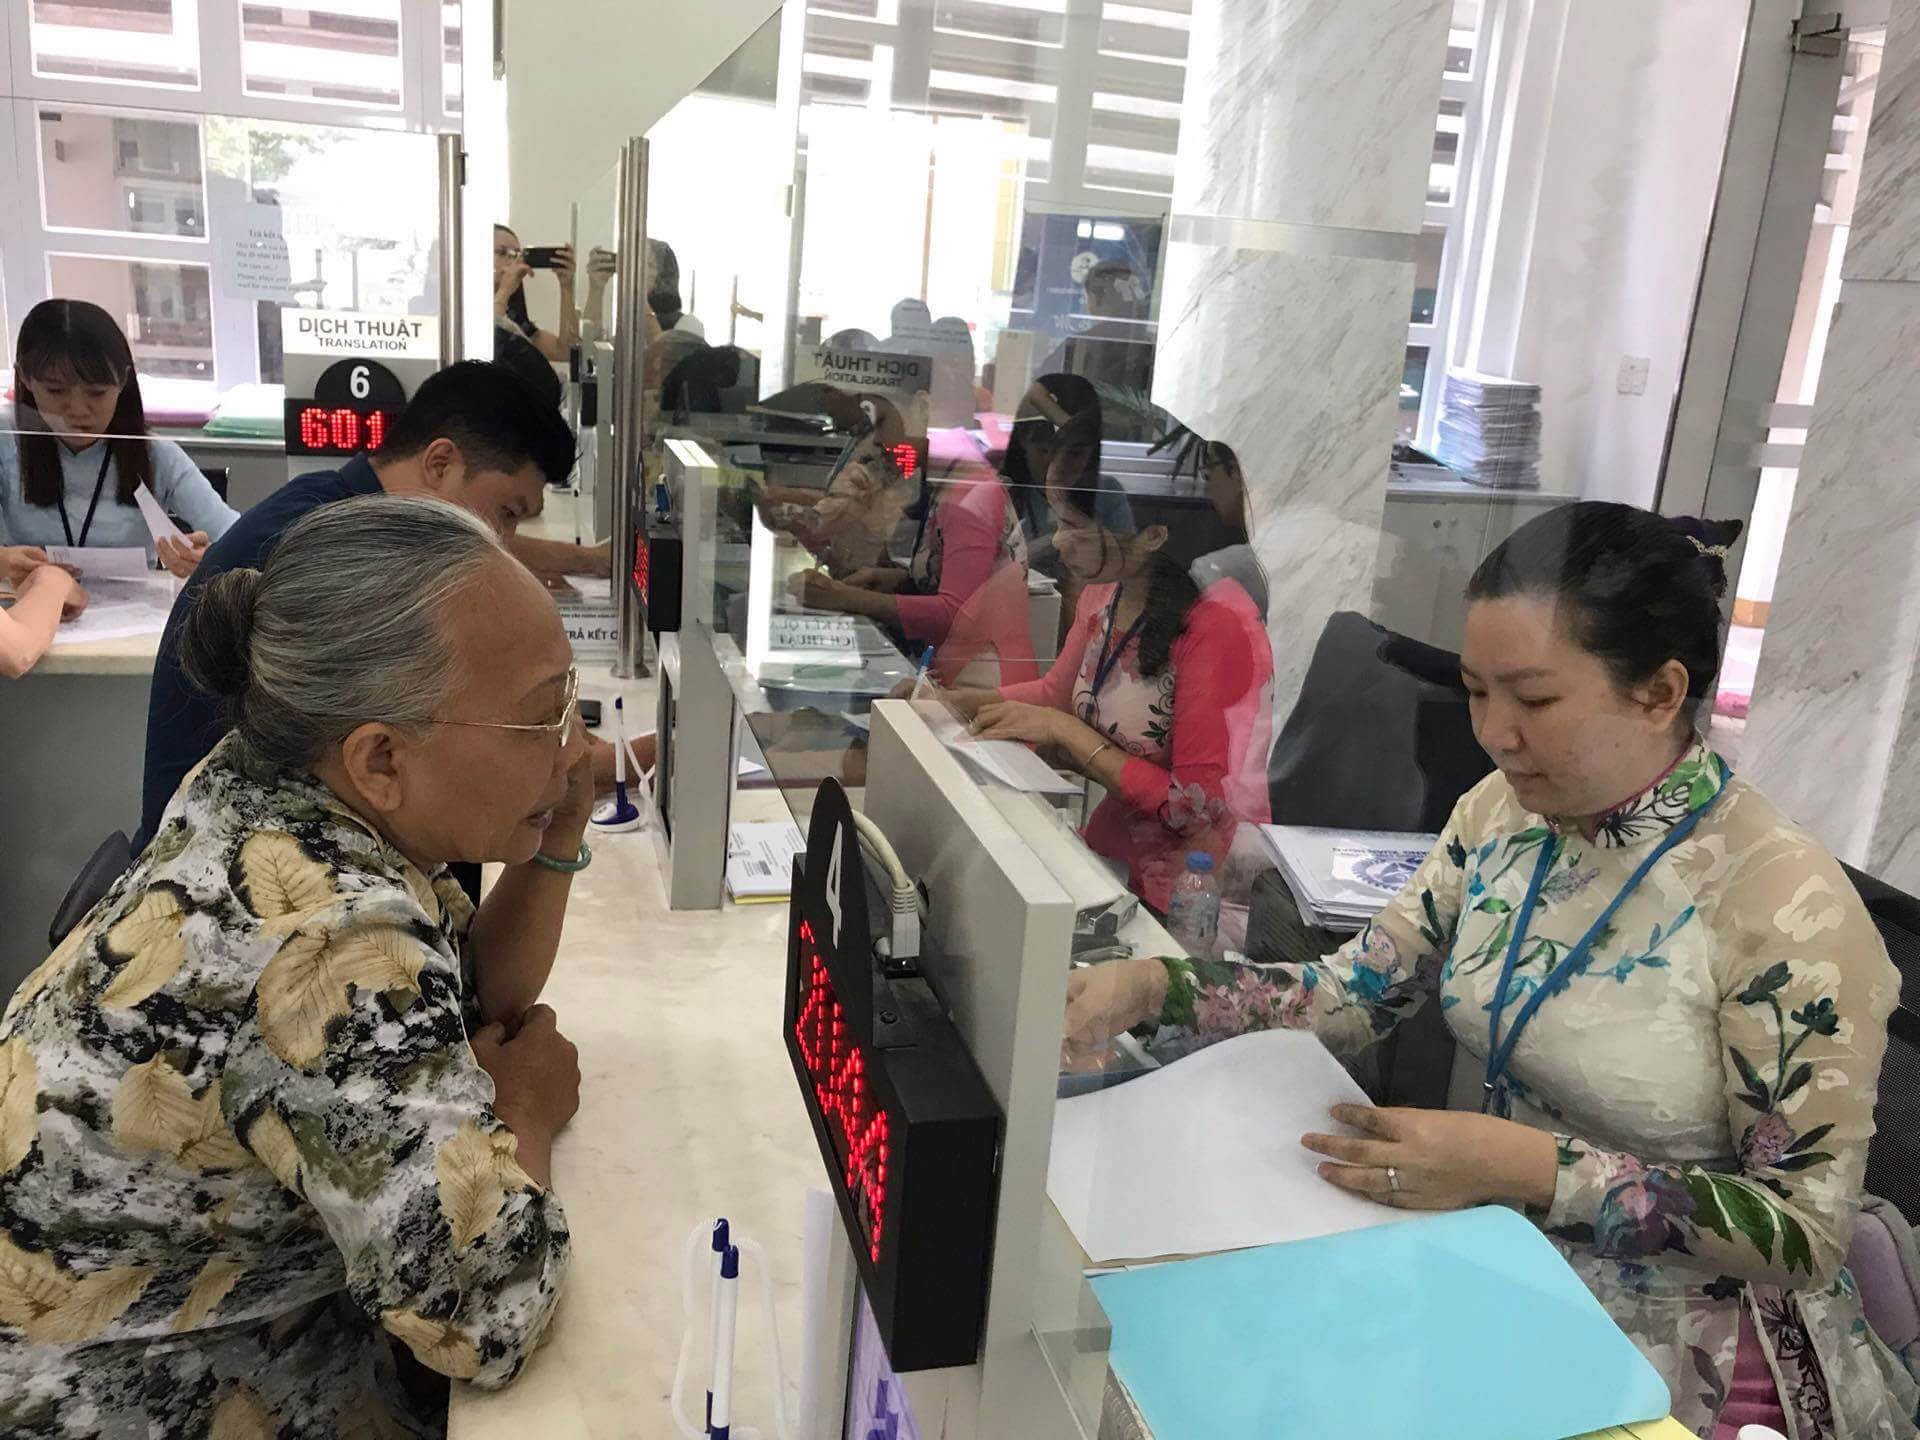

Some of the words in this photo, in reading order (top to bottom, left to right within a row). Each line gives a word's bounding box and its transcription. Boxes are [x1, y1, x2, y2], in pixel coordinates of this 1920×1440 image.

[299, 317, 348, 337] DỊCH
[354, 319, 422, 341] THUẬT
[319, 337, 407, 351] TRANSLATION
[350, 365, 370, 399] 6
[825, 820, 845, 950] 4
